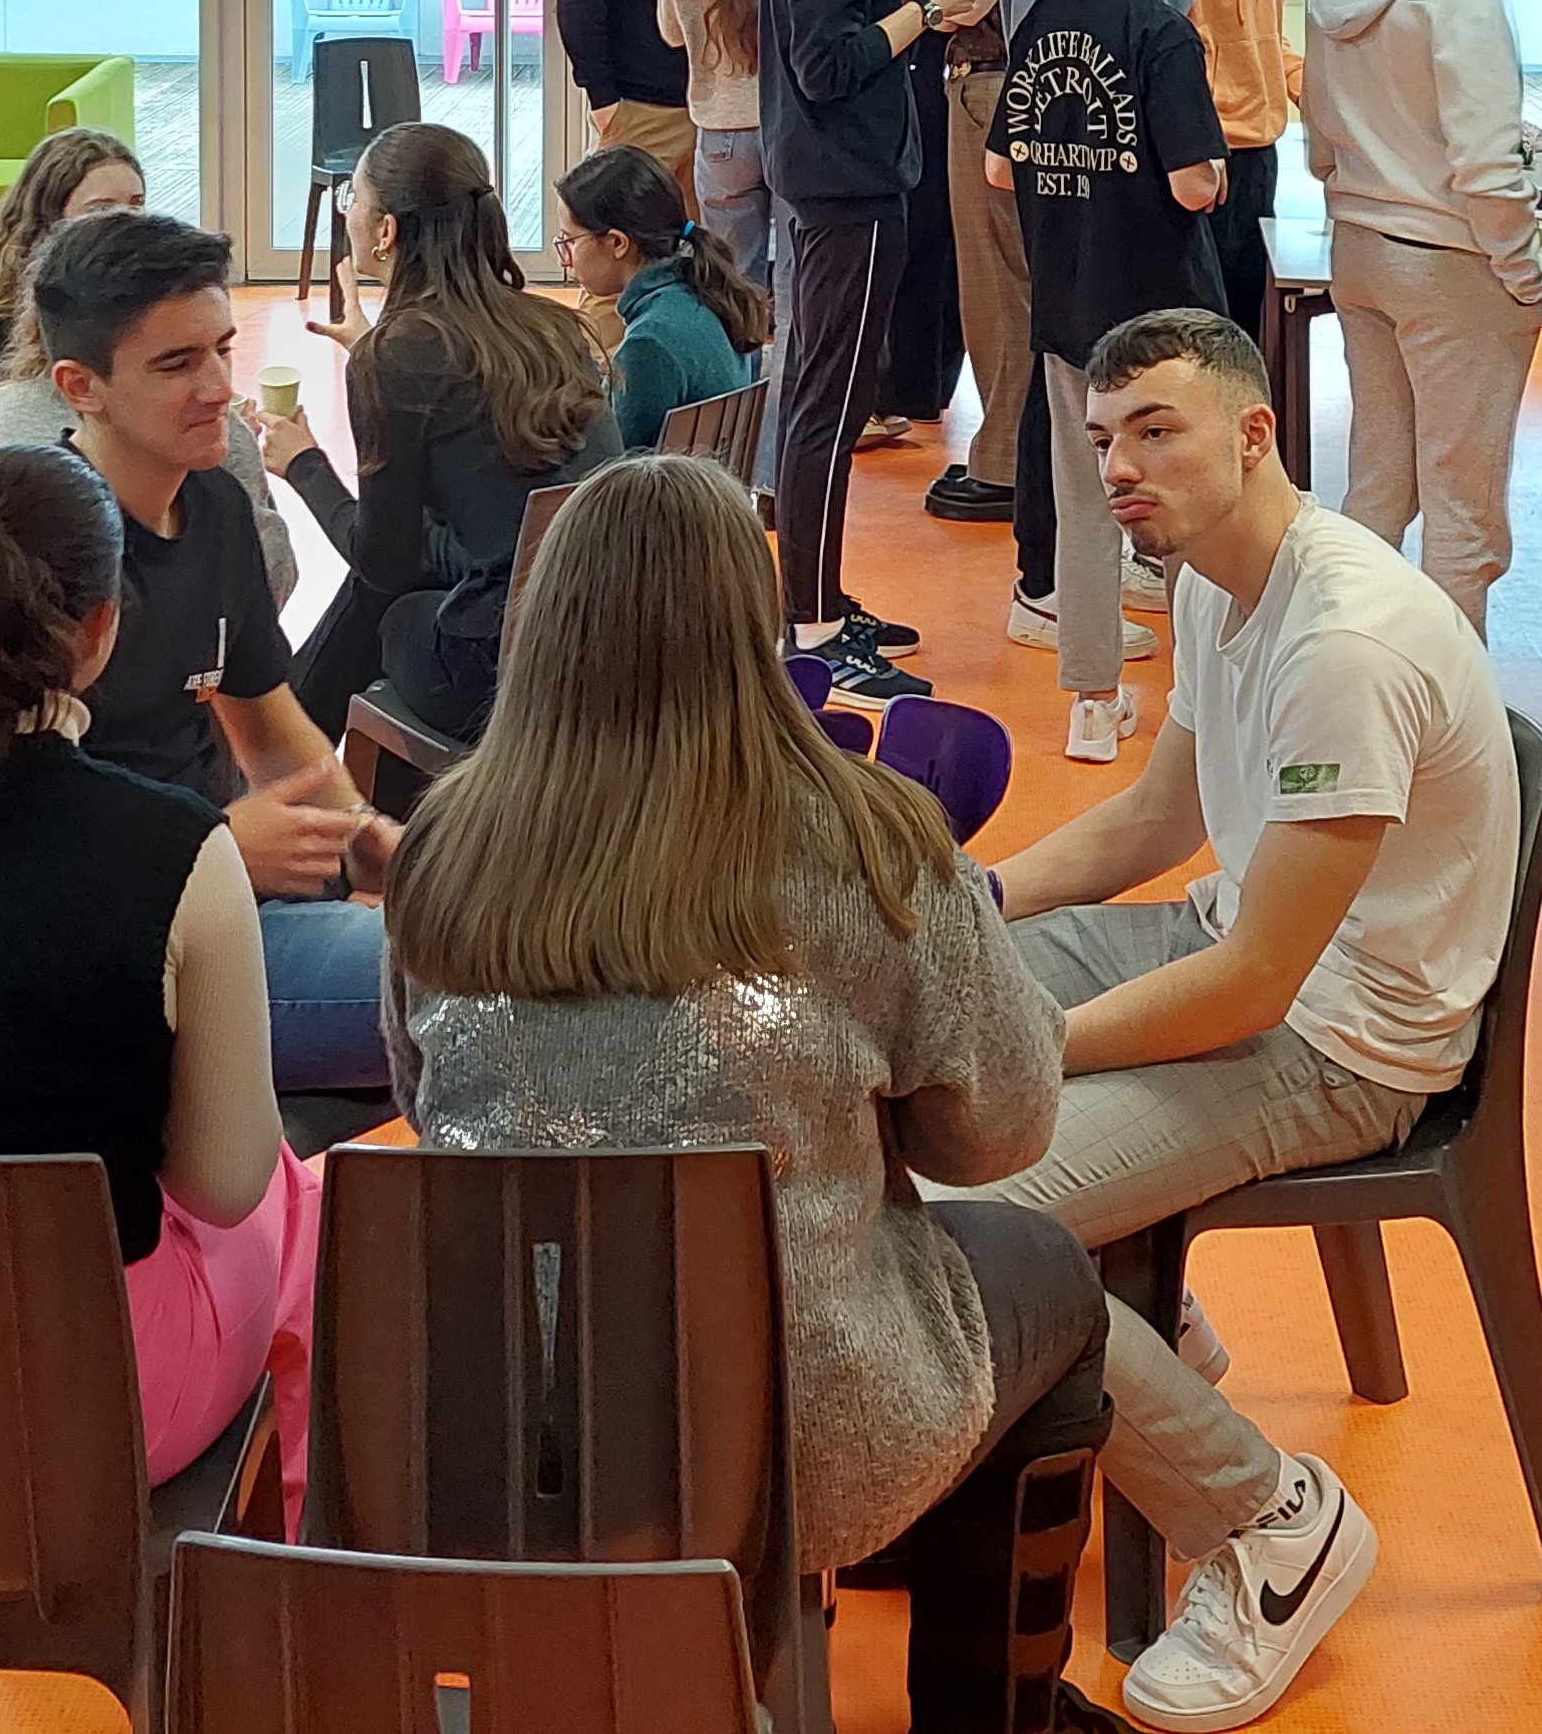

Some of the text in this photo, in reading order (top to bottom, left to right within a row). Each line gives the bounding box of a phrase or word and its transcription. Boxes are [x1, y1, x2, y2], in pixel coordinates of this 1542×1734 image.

[1006, 30, 1138, 147] WORK LIFE BALLADS
[1029, 139, 1091, 171] CRHART
[1036, 171, 1072, 196] EST.
